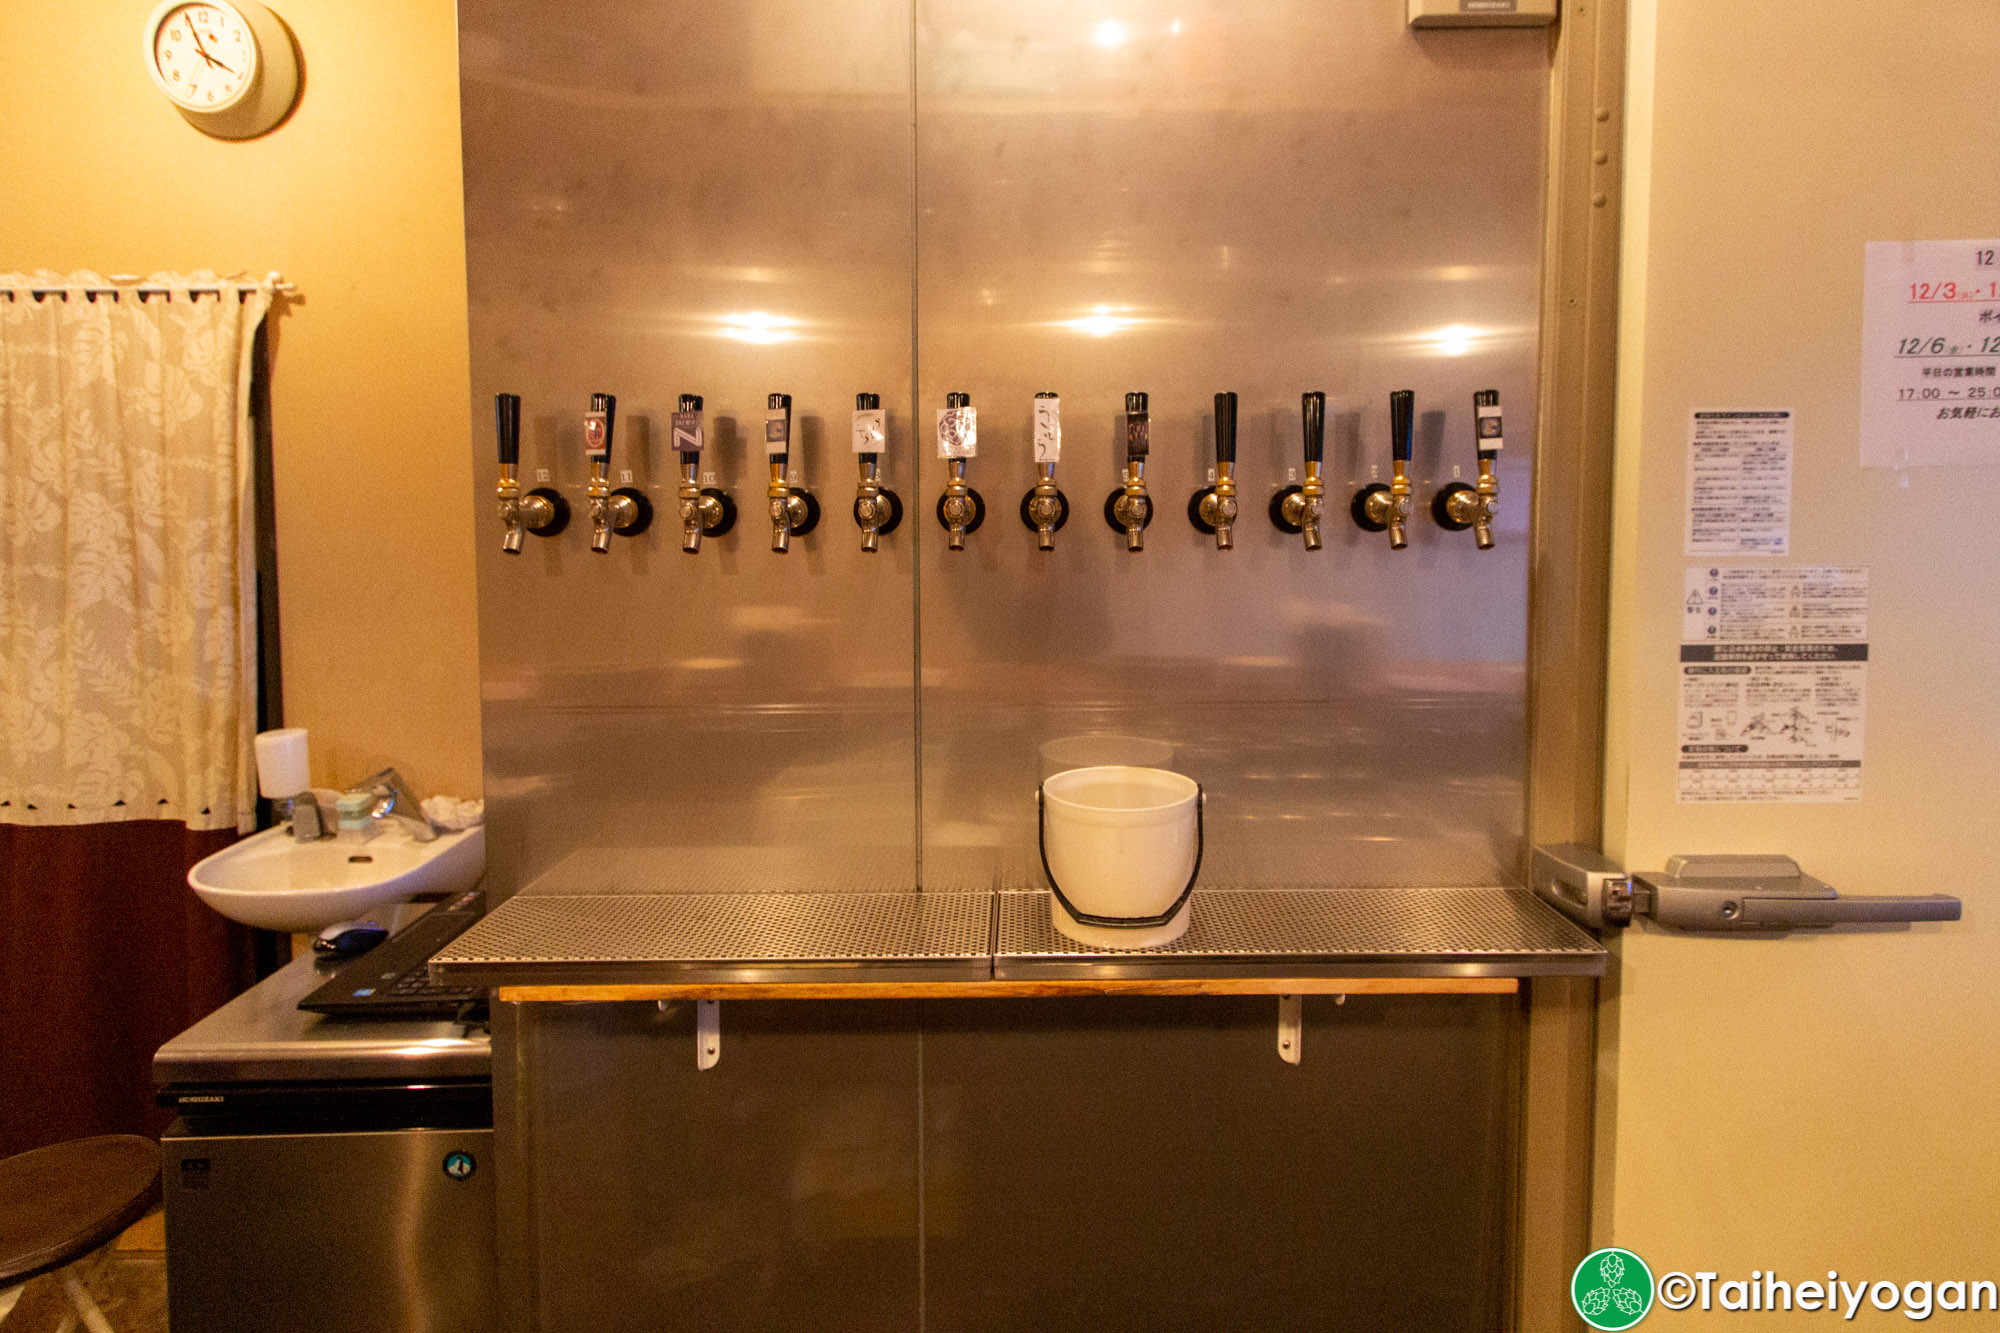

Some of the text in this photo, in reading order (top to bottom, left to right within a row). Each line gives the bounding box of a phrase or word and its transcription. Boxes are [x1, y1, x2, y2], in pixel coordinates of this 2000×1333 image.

[198, 11, 209, 23] 12
[170, 29, 182, 42] 10
[233, 29, 241, 42] 2
[165, 49, 173, 60] 9
[173, 69, 180, 82] 8
[189, 83, 198, 95] 7
[207, 90, 215, 102] 6
